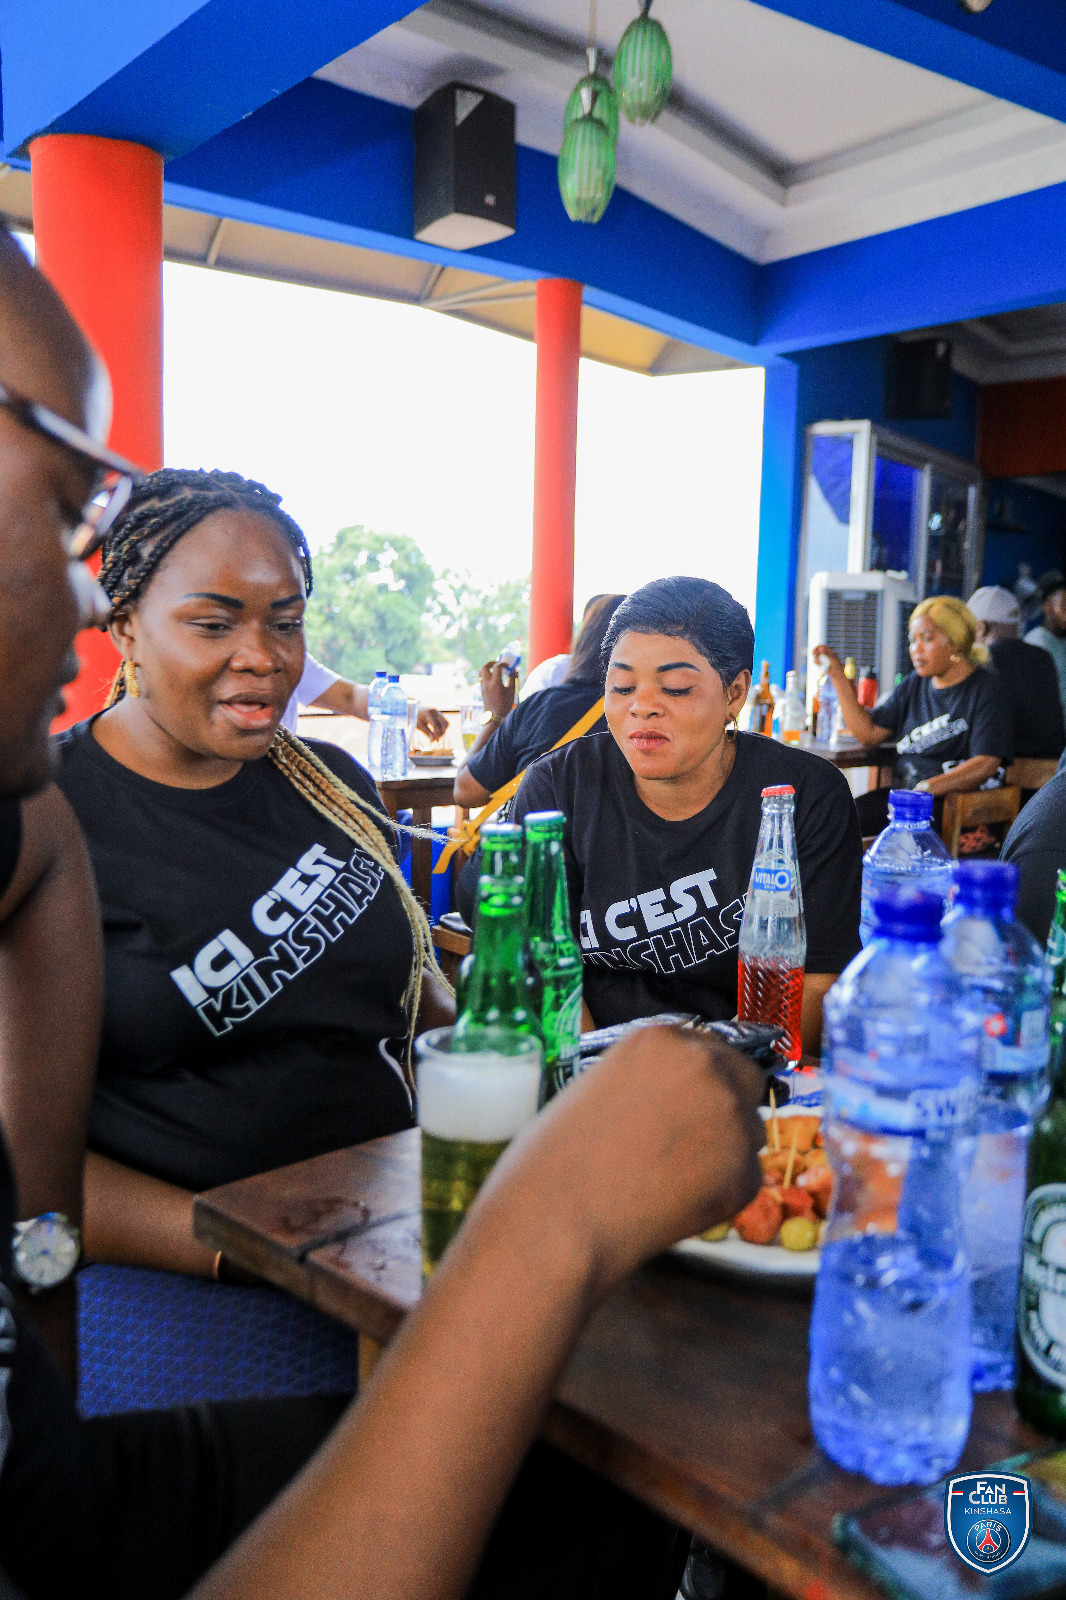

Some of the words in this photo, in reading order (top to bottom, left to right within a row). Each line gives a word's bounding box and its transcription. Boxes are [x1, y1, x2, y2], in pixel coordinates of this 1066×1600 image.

[604, 867, 719, 942] C'EST
[755, 871, 790, 889] VITALO
[170, 928, 254, 1008] ICI
[251, 843, 347, 937] C'EST
